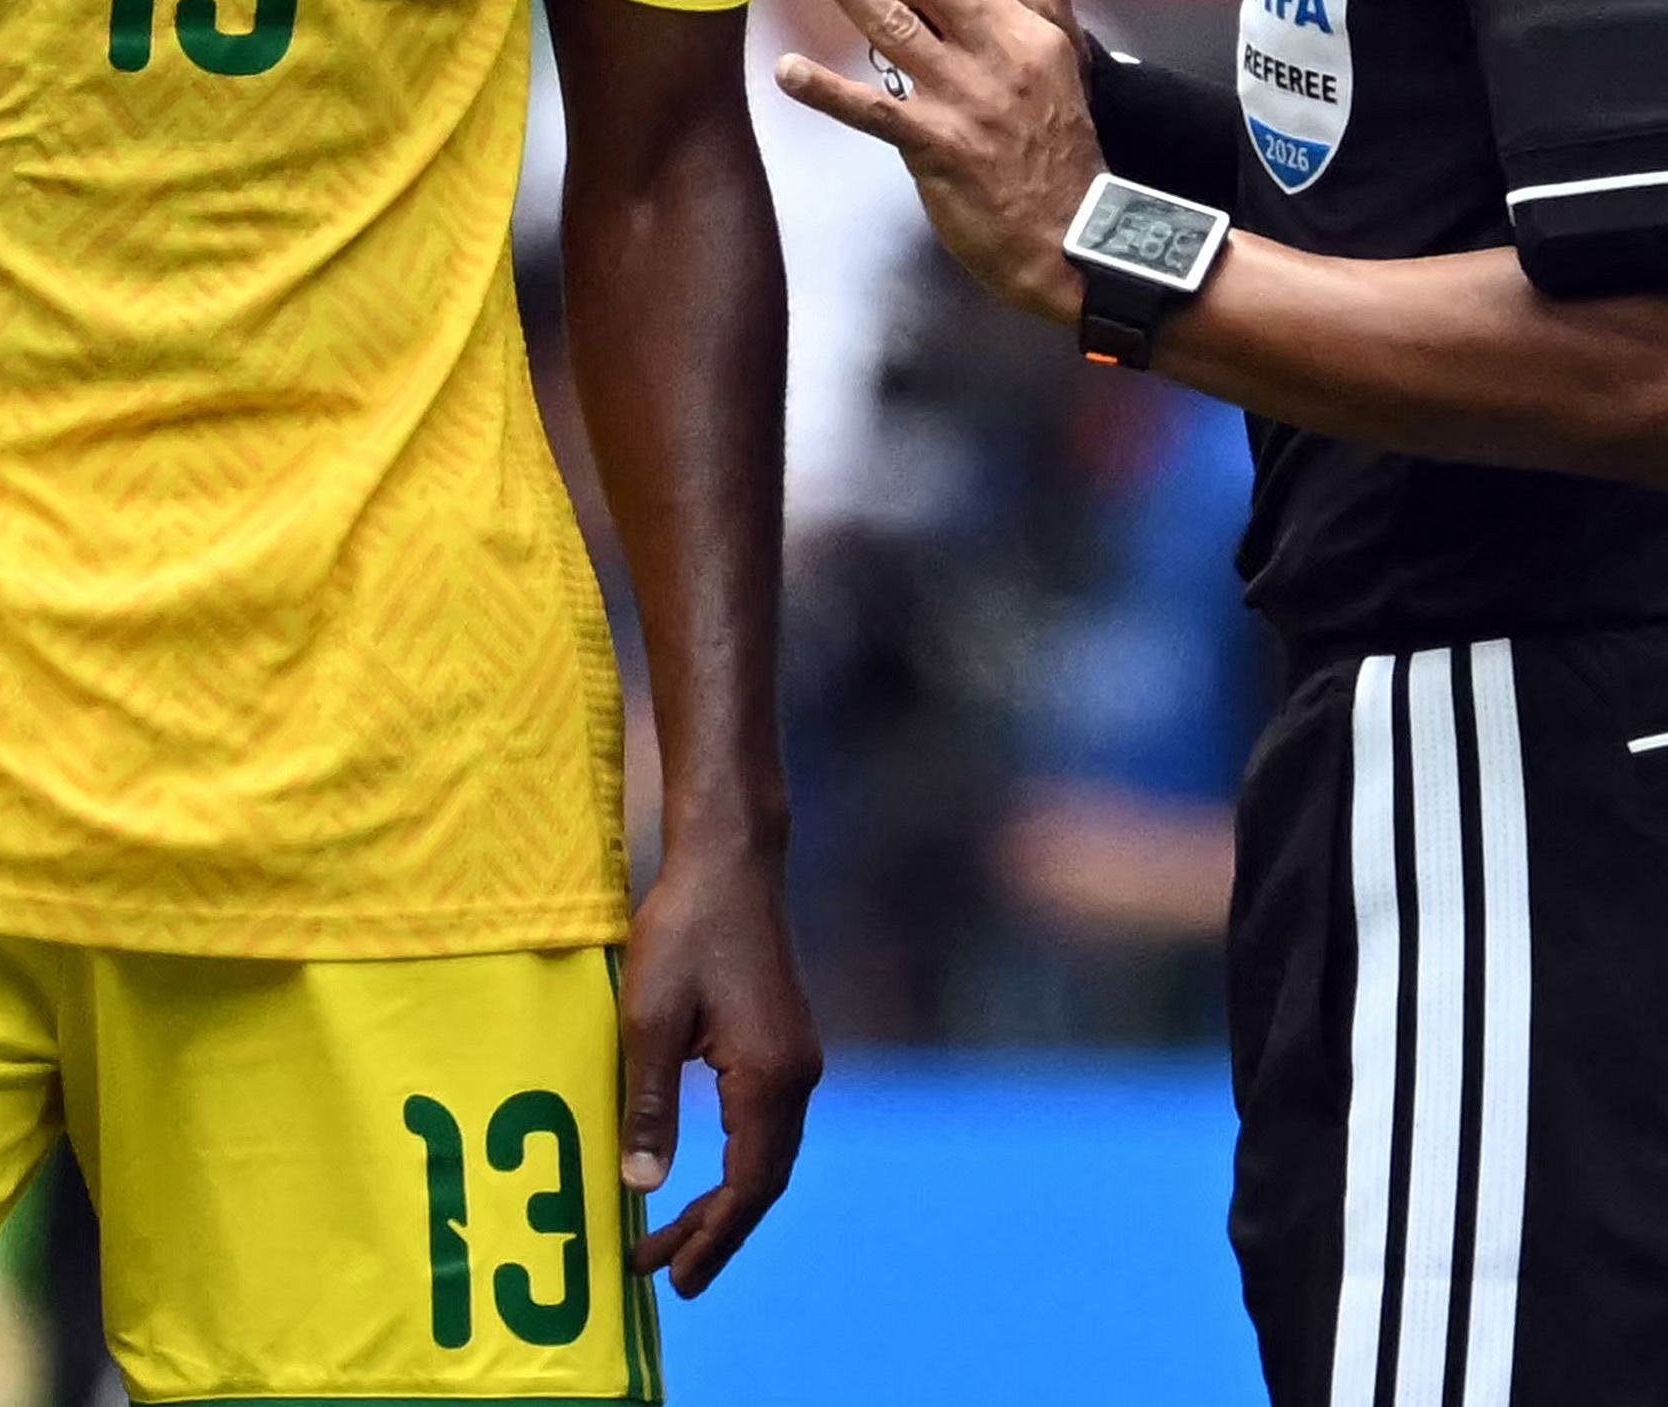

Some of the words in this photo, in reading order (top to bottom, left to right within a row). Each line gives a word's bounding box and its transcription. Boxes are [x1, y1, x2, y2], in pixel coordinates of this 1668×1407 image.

[1243, 44, 1338, 104] REFEREE
[1264, 134, 1310, 171] 2026
[403, 1090, 590, 1349] 13
